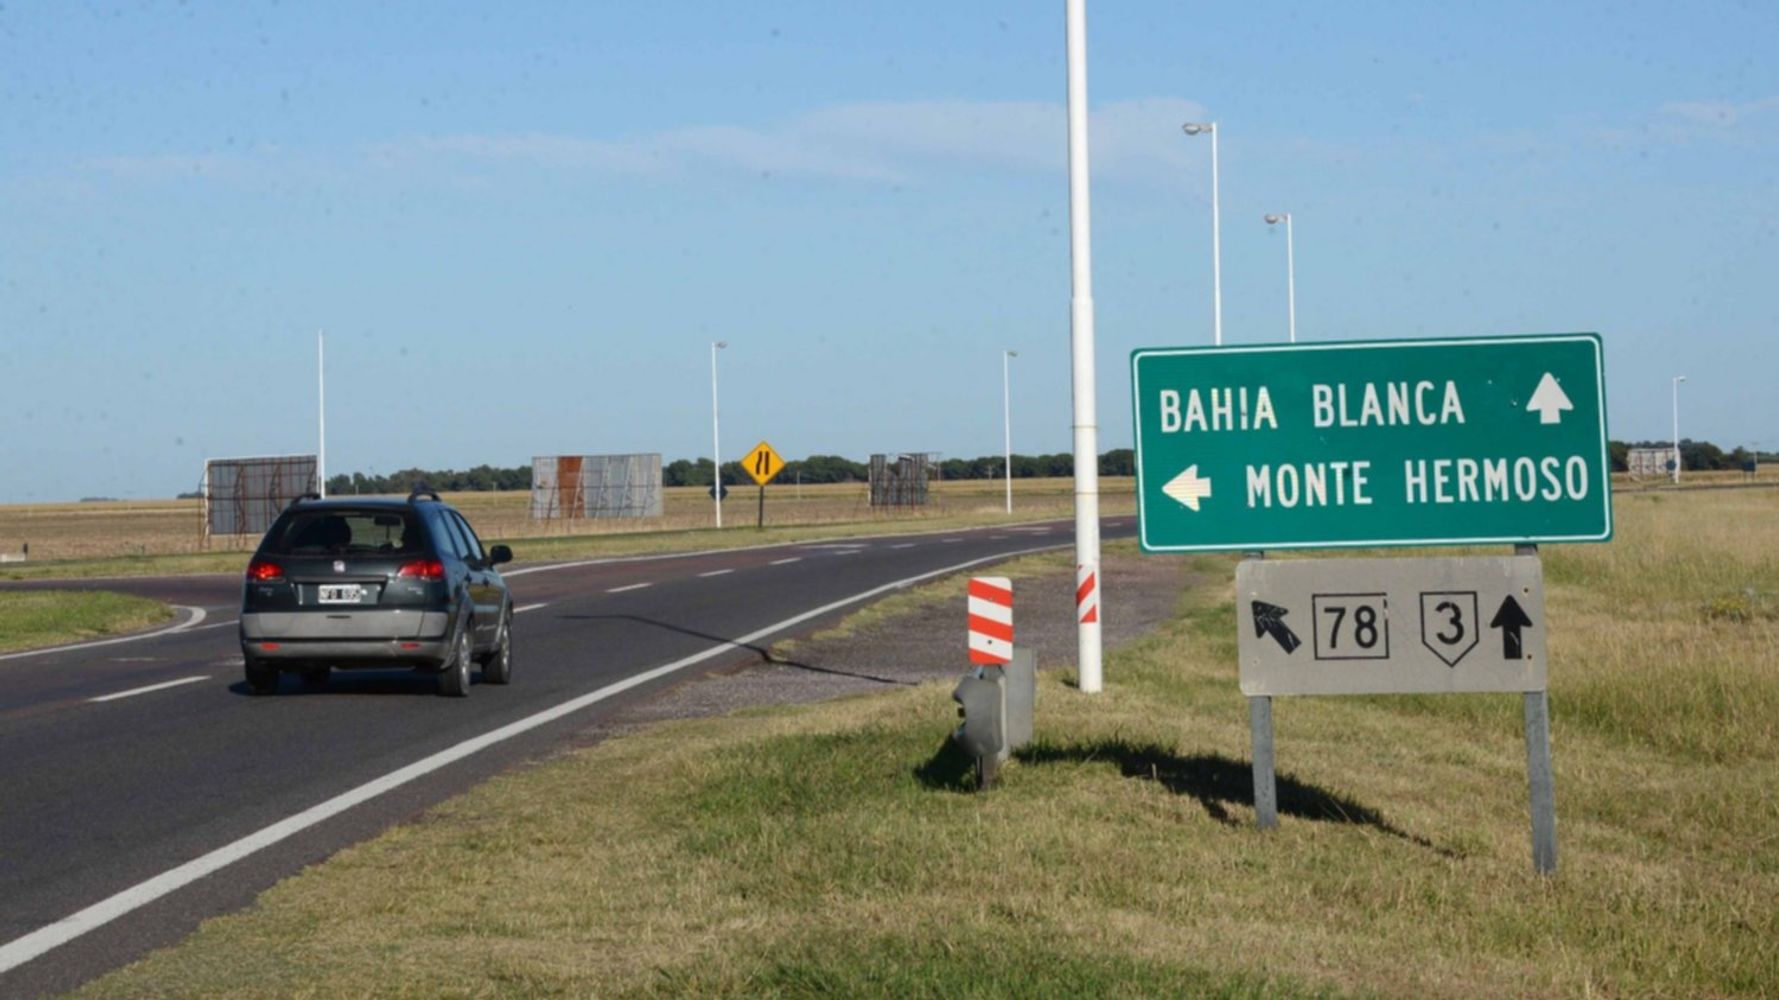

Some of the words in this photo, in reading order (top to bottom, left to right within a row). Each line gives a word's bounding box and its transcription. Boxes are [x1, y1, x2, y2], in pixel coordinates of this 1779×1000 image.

[1160, 387, 1278, 432] BAHIA
[1313, 380, 1465, 427] BLANCA
[1246, 461, 1372, 508] MONTE
[1405, 456, 1588, 503] HERMOSO
[1324, 605, 1378, 649] 78
[1435, 602, 1464, 645] 3
